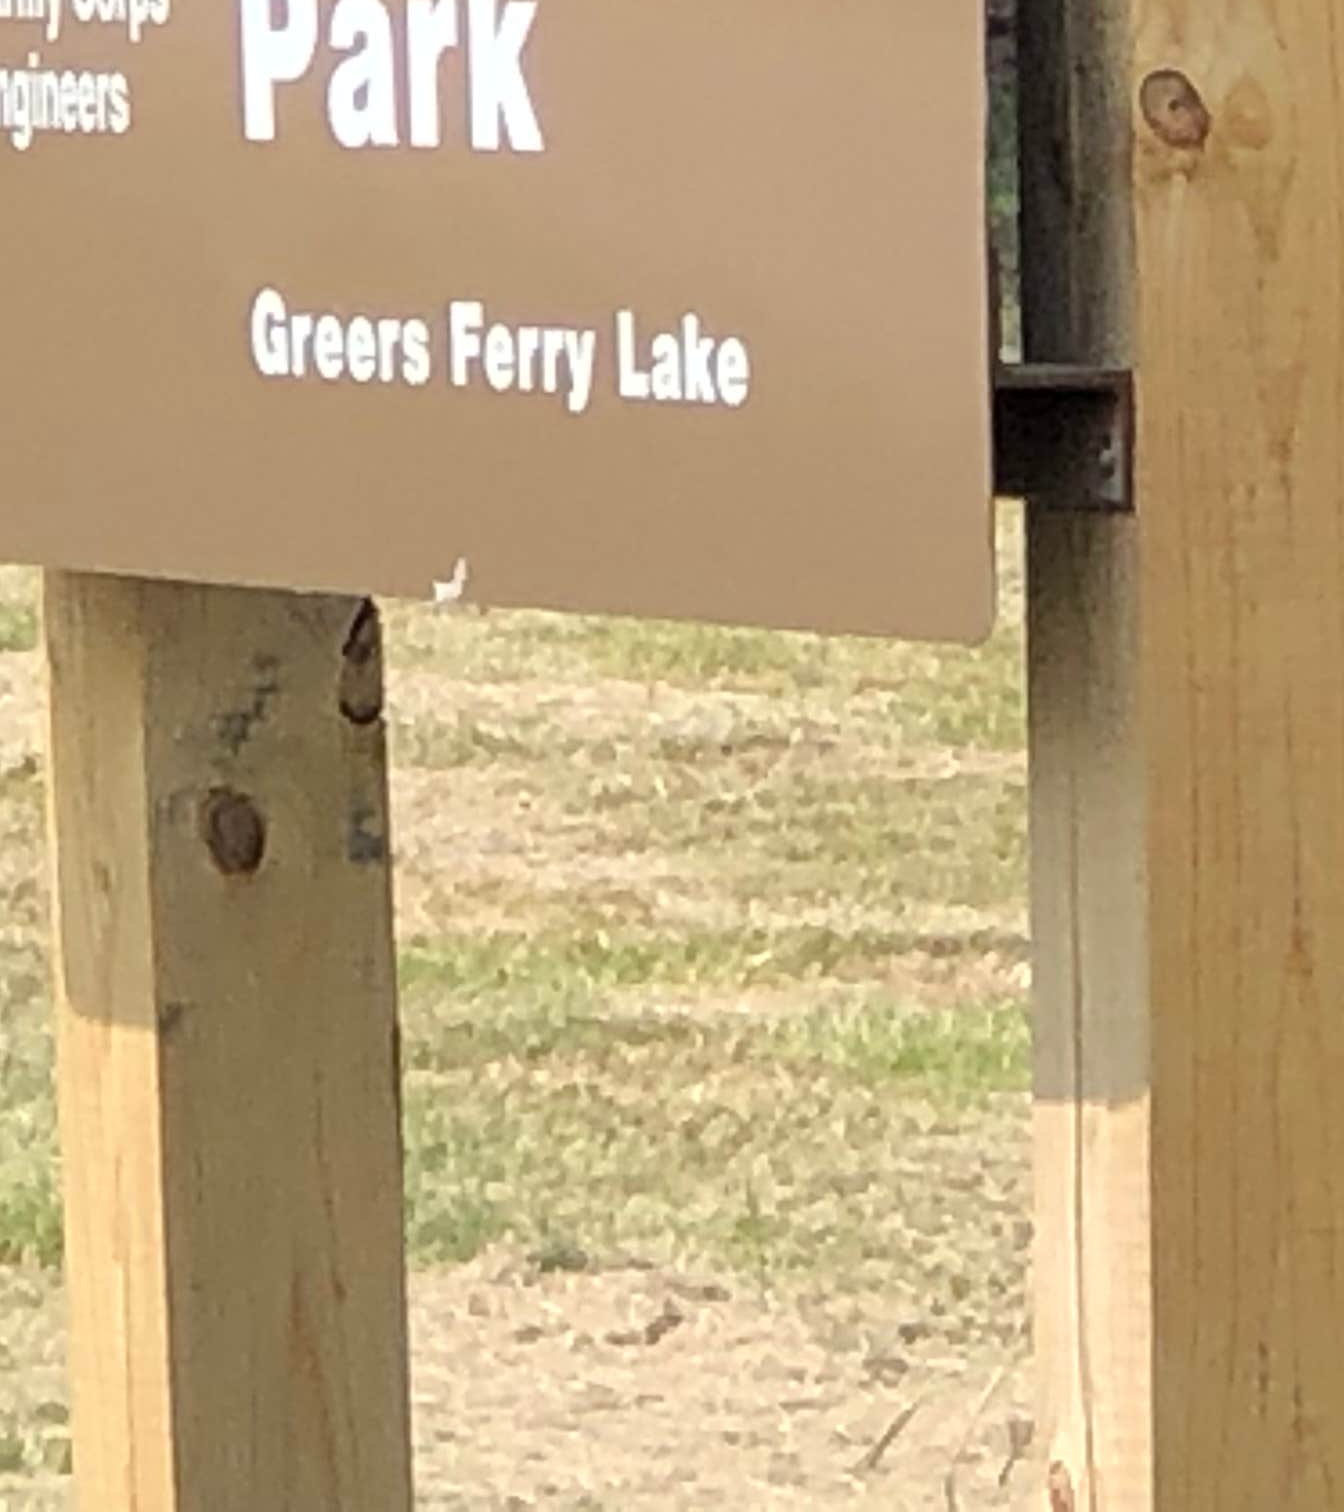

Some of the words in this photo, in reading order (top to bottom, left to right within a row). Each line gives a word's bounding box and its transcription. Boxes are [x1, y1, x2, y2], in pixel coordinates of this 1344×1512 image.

[252, 288, 431, 386] Greers
[449, 300, 596, 413] Ferry
[617, 309, 750, 407] Lake
